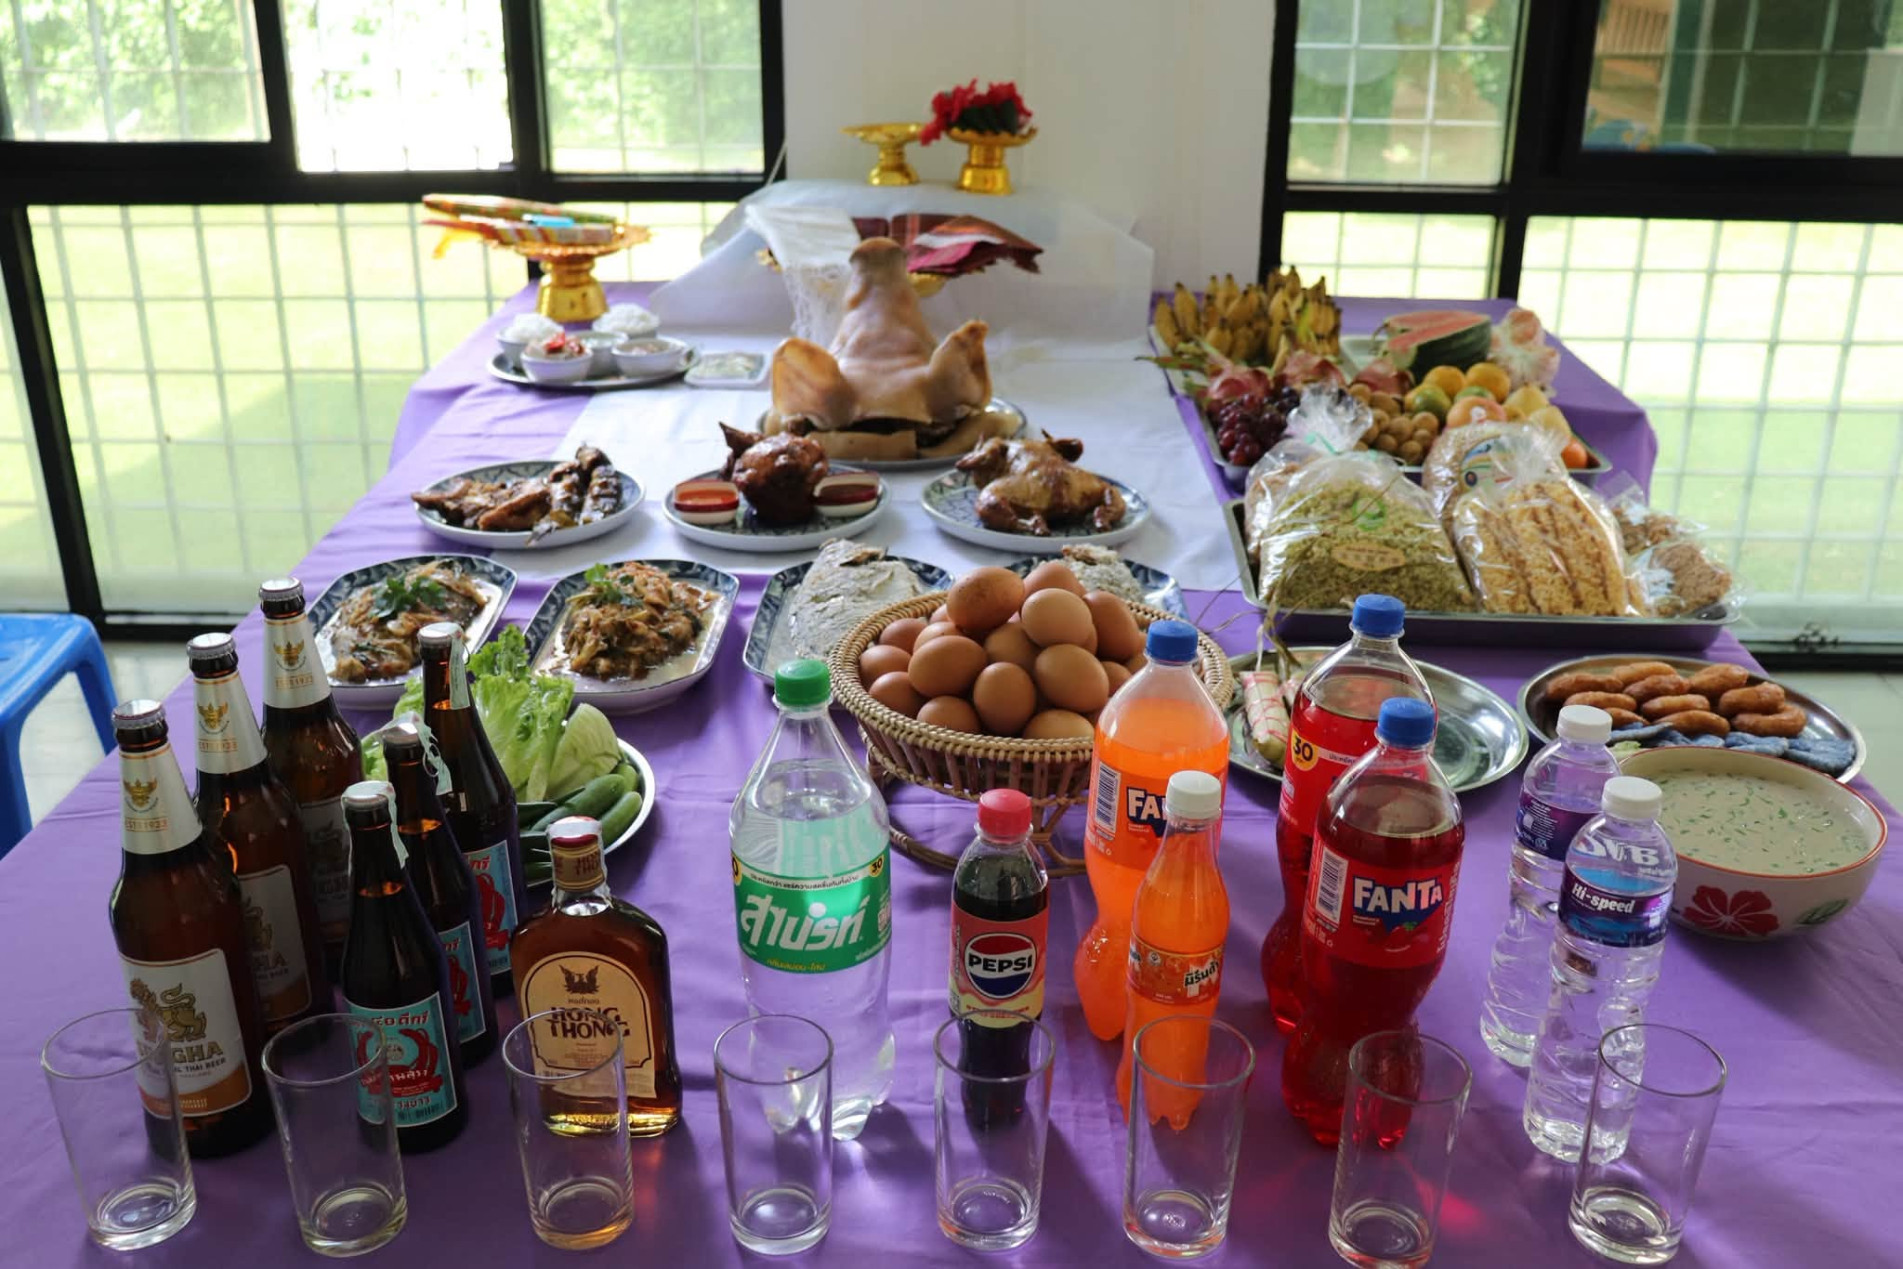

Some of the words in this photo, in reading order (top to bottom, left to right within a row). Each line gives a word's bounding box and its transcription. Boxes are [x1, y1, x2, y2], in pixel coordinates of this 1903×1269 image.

[1293, 736, 1313, 762] 30
[871, 857, 883, 873] 30
[1353, 877, 1443, 914] FANTA
[1571, 882, 1636, 913] Hi-speed
[968, 952, 1033, 973] PEPSI
[550, 1007, 621, 1022] HONG
[546, 1018, 631, 1039] THONG
[185, 1064, 204, 1073] THAI
[206, 1058, 227, 1069] BEER
